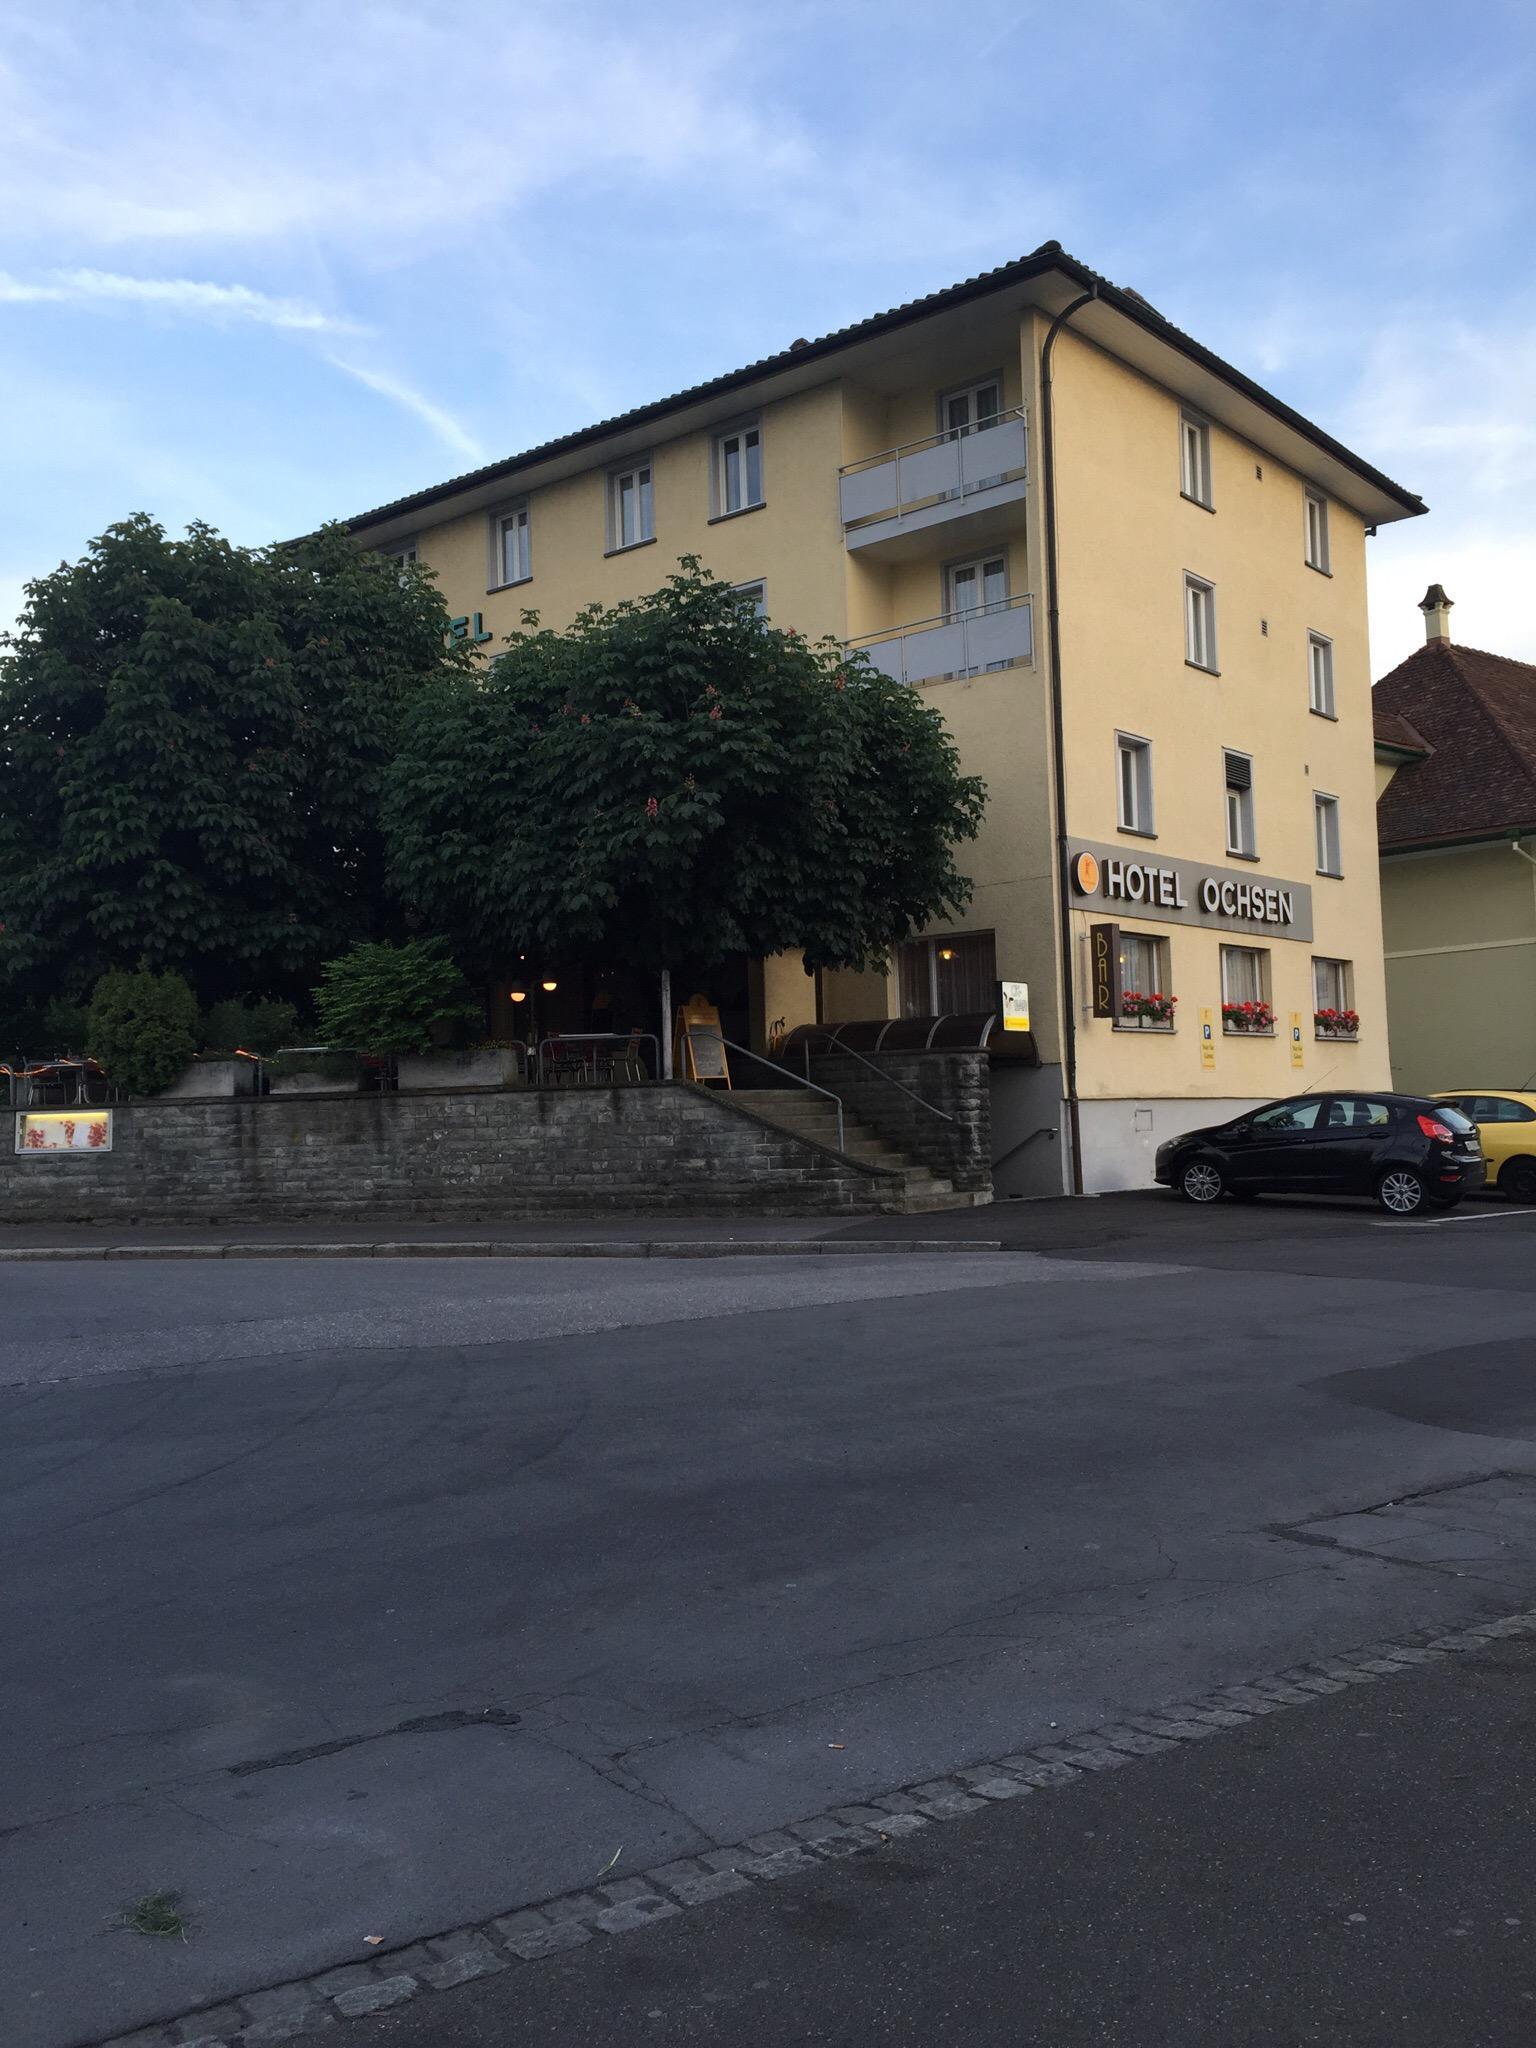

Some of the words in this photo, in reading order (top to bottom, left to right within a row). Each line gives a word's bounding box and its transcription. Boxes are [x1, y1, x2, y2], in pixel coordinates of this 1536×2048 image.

[446, 612, 493, 648] EL
[1104, 858, 1188, 908] HOTEL
[1201, 877, 1294, 924] OCHSEN
[1096, 932, 1109, 1009] BAR
